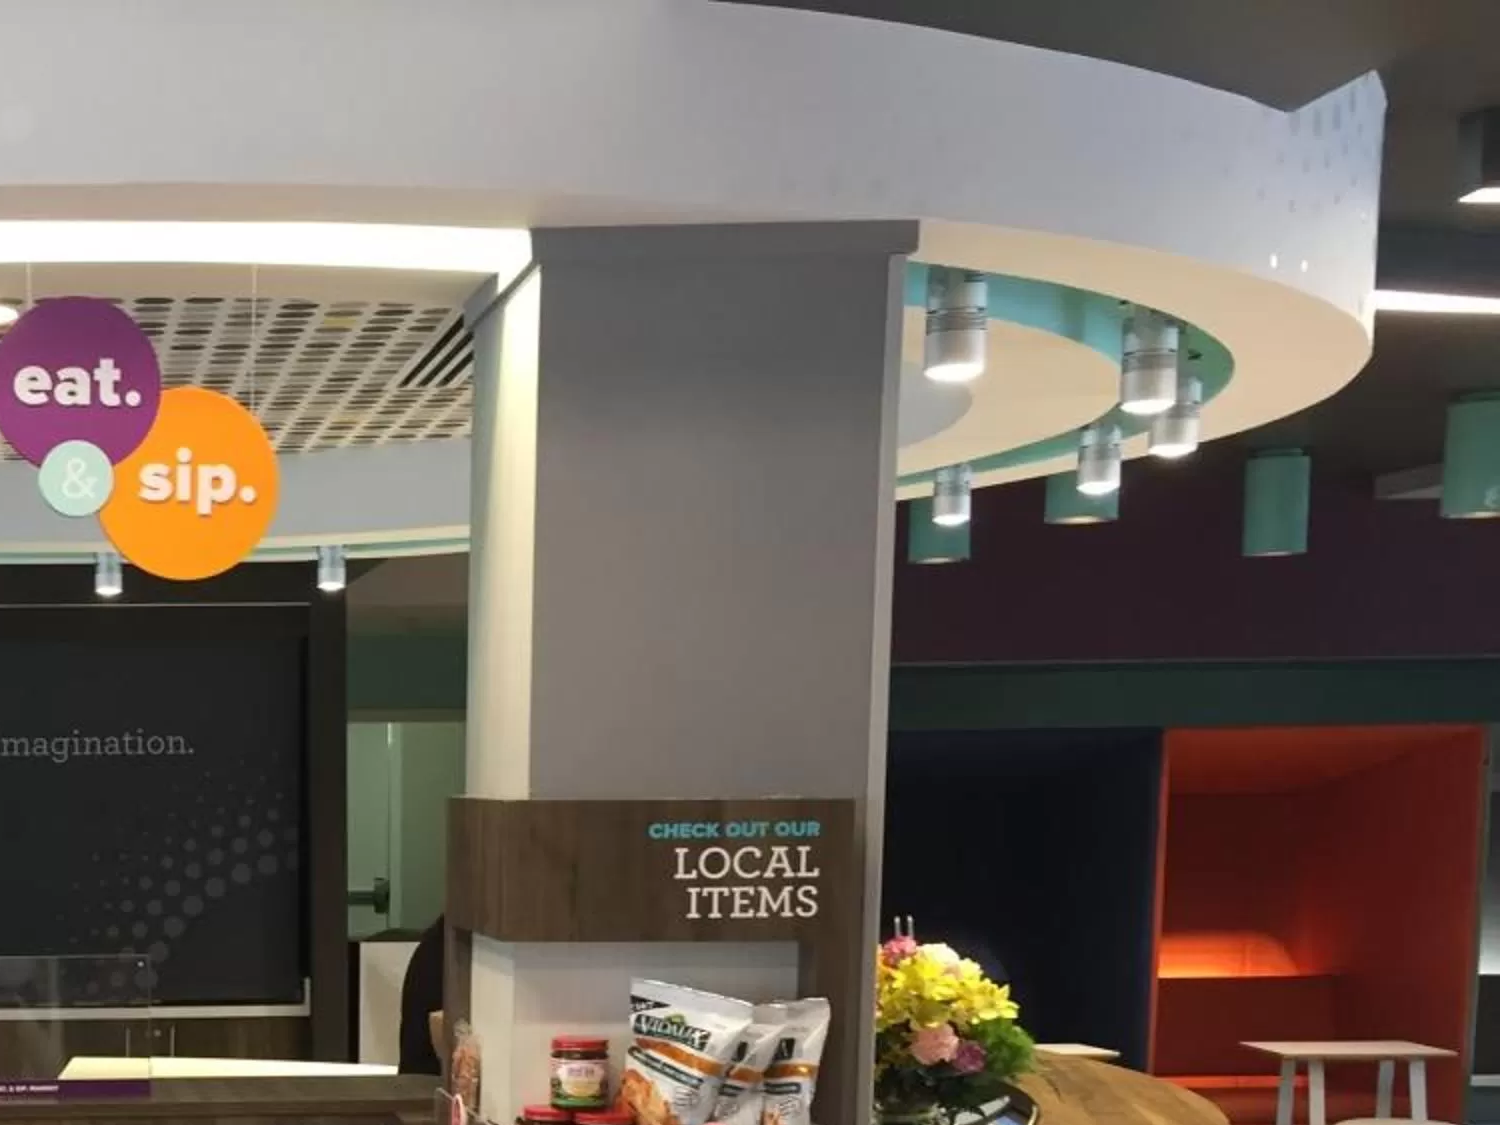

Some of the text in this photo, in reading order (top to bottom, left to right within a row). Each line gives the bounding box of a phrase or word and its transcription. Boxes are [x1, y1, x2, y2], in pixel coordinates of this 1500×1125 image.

[13, 357, 143, 407] eat.
[62, 457, 97, 500] &
[138, 447, 257, 516] sip.
[649, 821, 821, 838] CHECK OUT OUR
[673, 846, 821, 880] LOCAL
[686, 885, 820, 919] ITEMS
